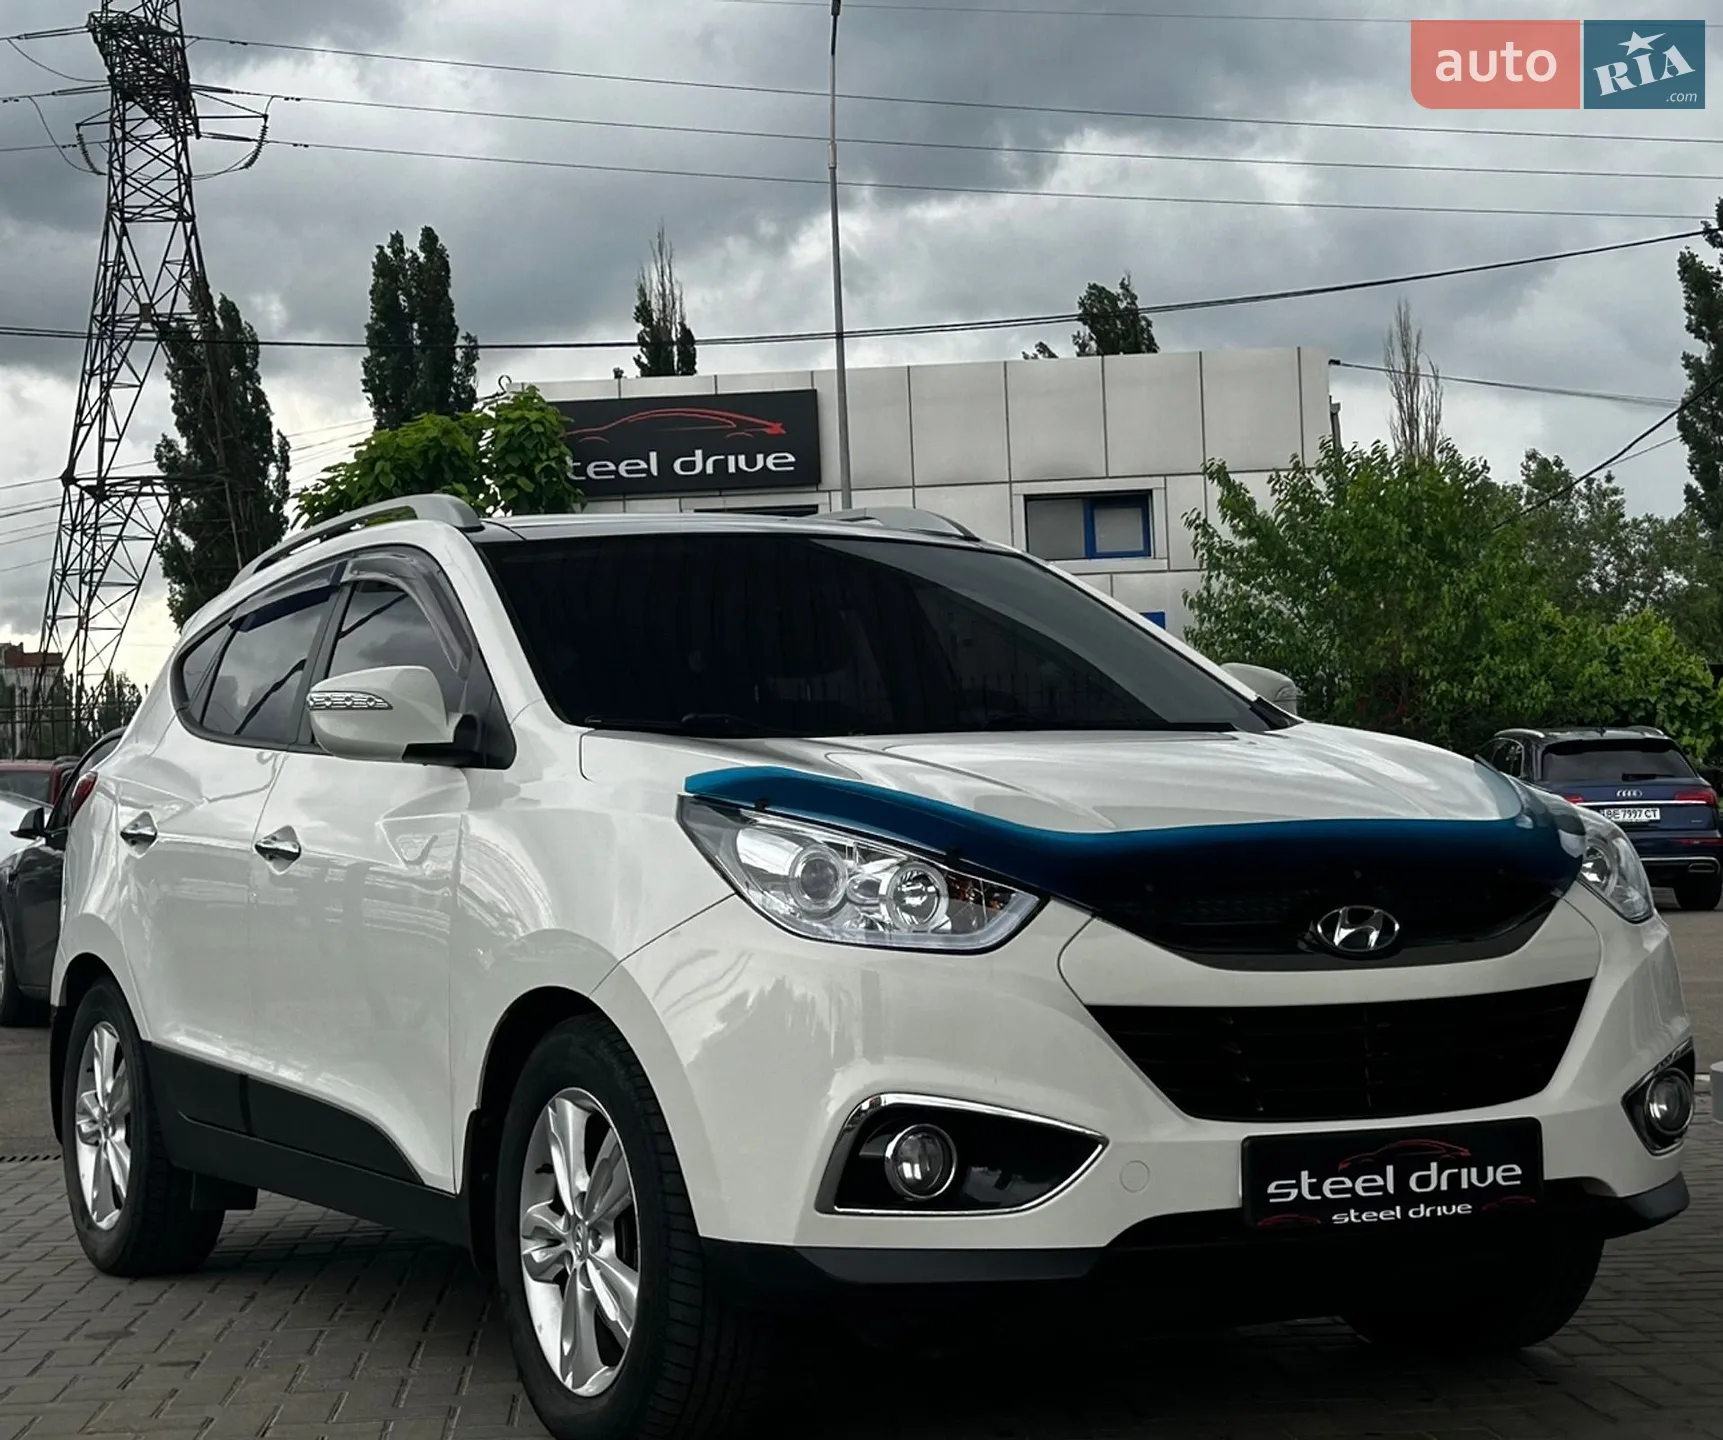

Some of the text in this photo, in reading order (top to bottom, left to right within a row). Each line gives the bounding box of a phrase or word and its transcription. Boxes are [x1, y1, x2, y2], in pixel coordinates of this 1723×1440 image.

[565, 449, 796, 481] teel drive
[1644, 808, 1658, 818] CT
[1266, 1161, 1523, 1203] steel drive
[1331, 1202, 1473, 1224] steel drive
